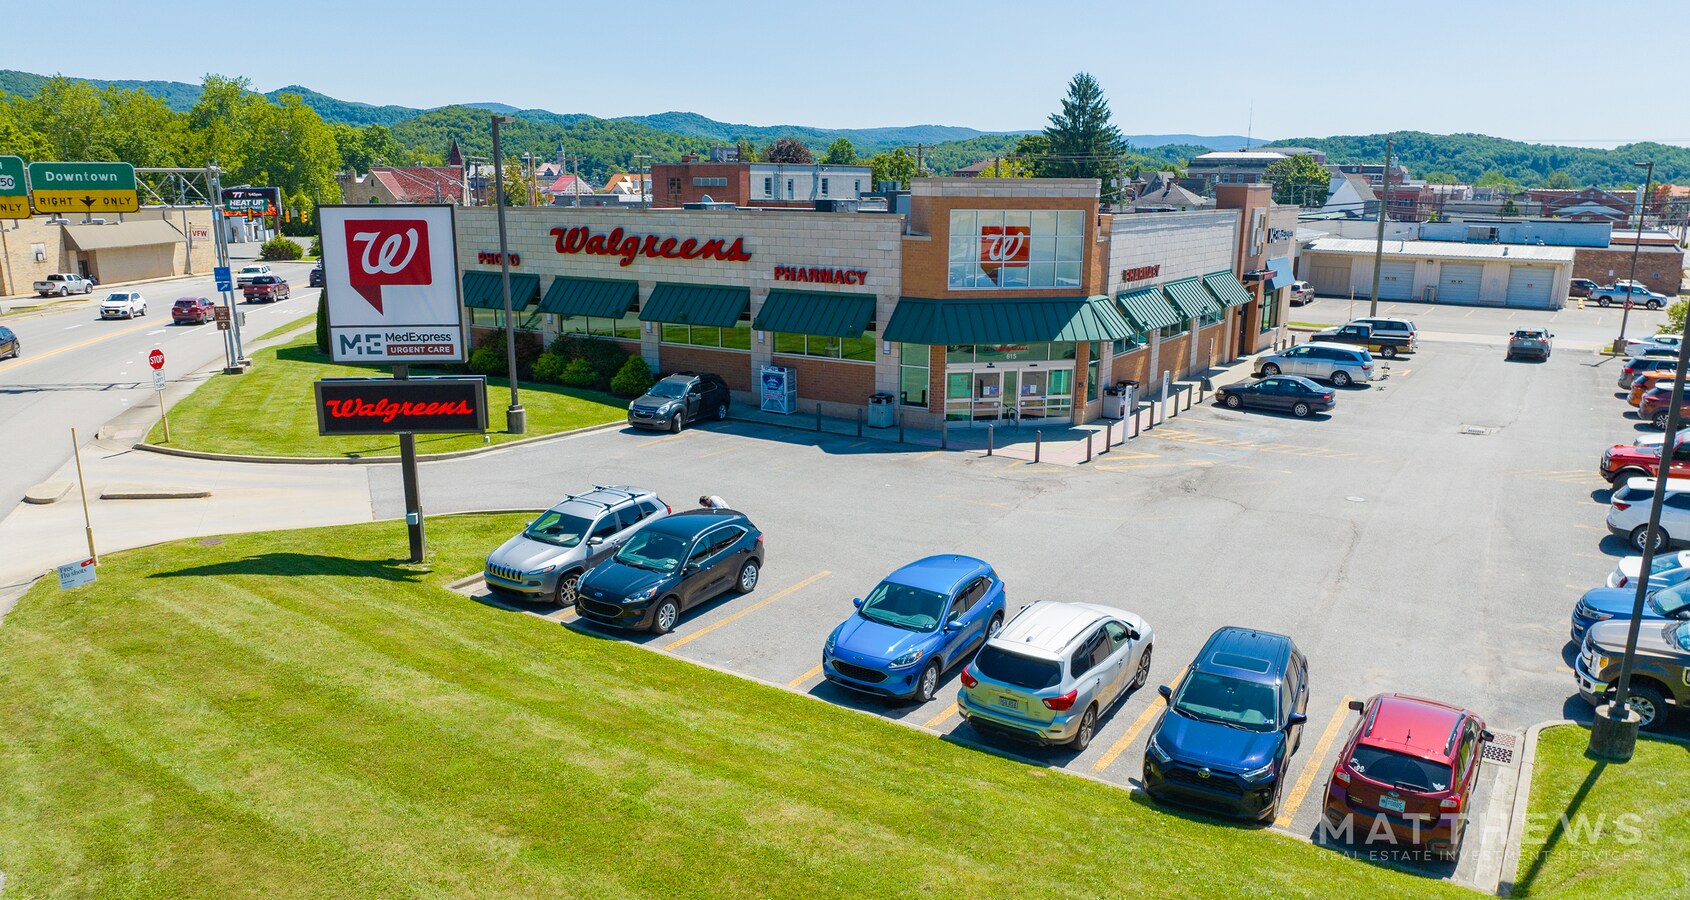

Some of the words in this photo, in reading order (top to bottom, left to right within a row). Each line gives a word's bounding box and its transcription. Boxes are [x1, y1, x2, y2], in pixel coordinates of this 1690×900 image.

[0, 178, 14, 187] 50
[45, 171, 118, 181] Downtown
[40, 197, 73, 206] RIGHT
[103, 197, 131, 206] ONLY
[550, 226, 752, 267] Walgreens
[478, 252, 520, 266] PHOO
[774, 266, 868, 285] PHARMACY
[1123, 265, 1160, 283] PHARMACY
[340, 334, 383, 355] ME
[385, 332, 452, 343] MedExpress
[150, 355, 164, 364] STOP
[326, 398, 473, 423] Walgreens
